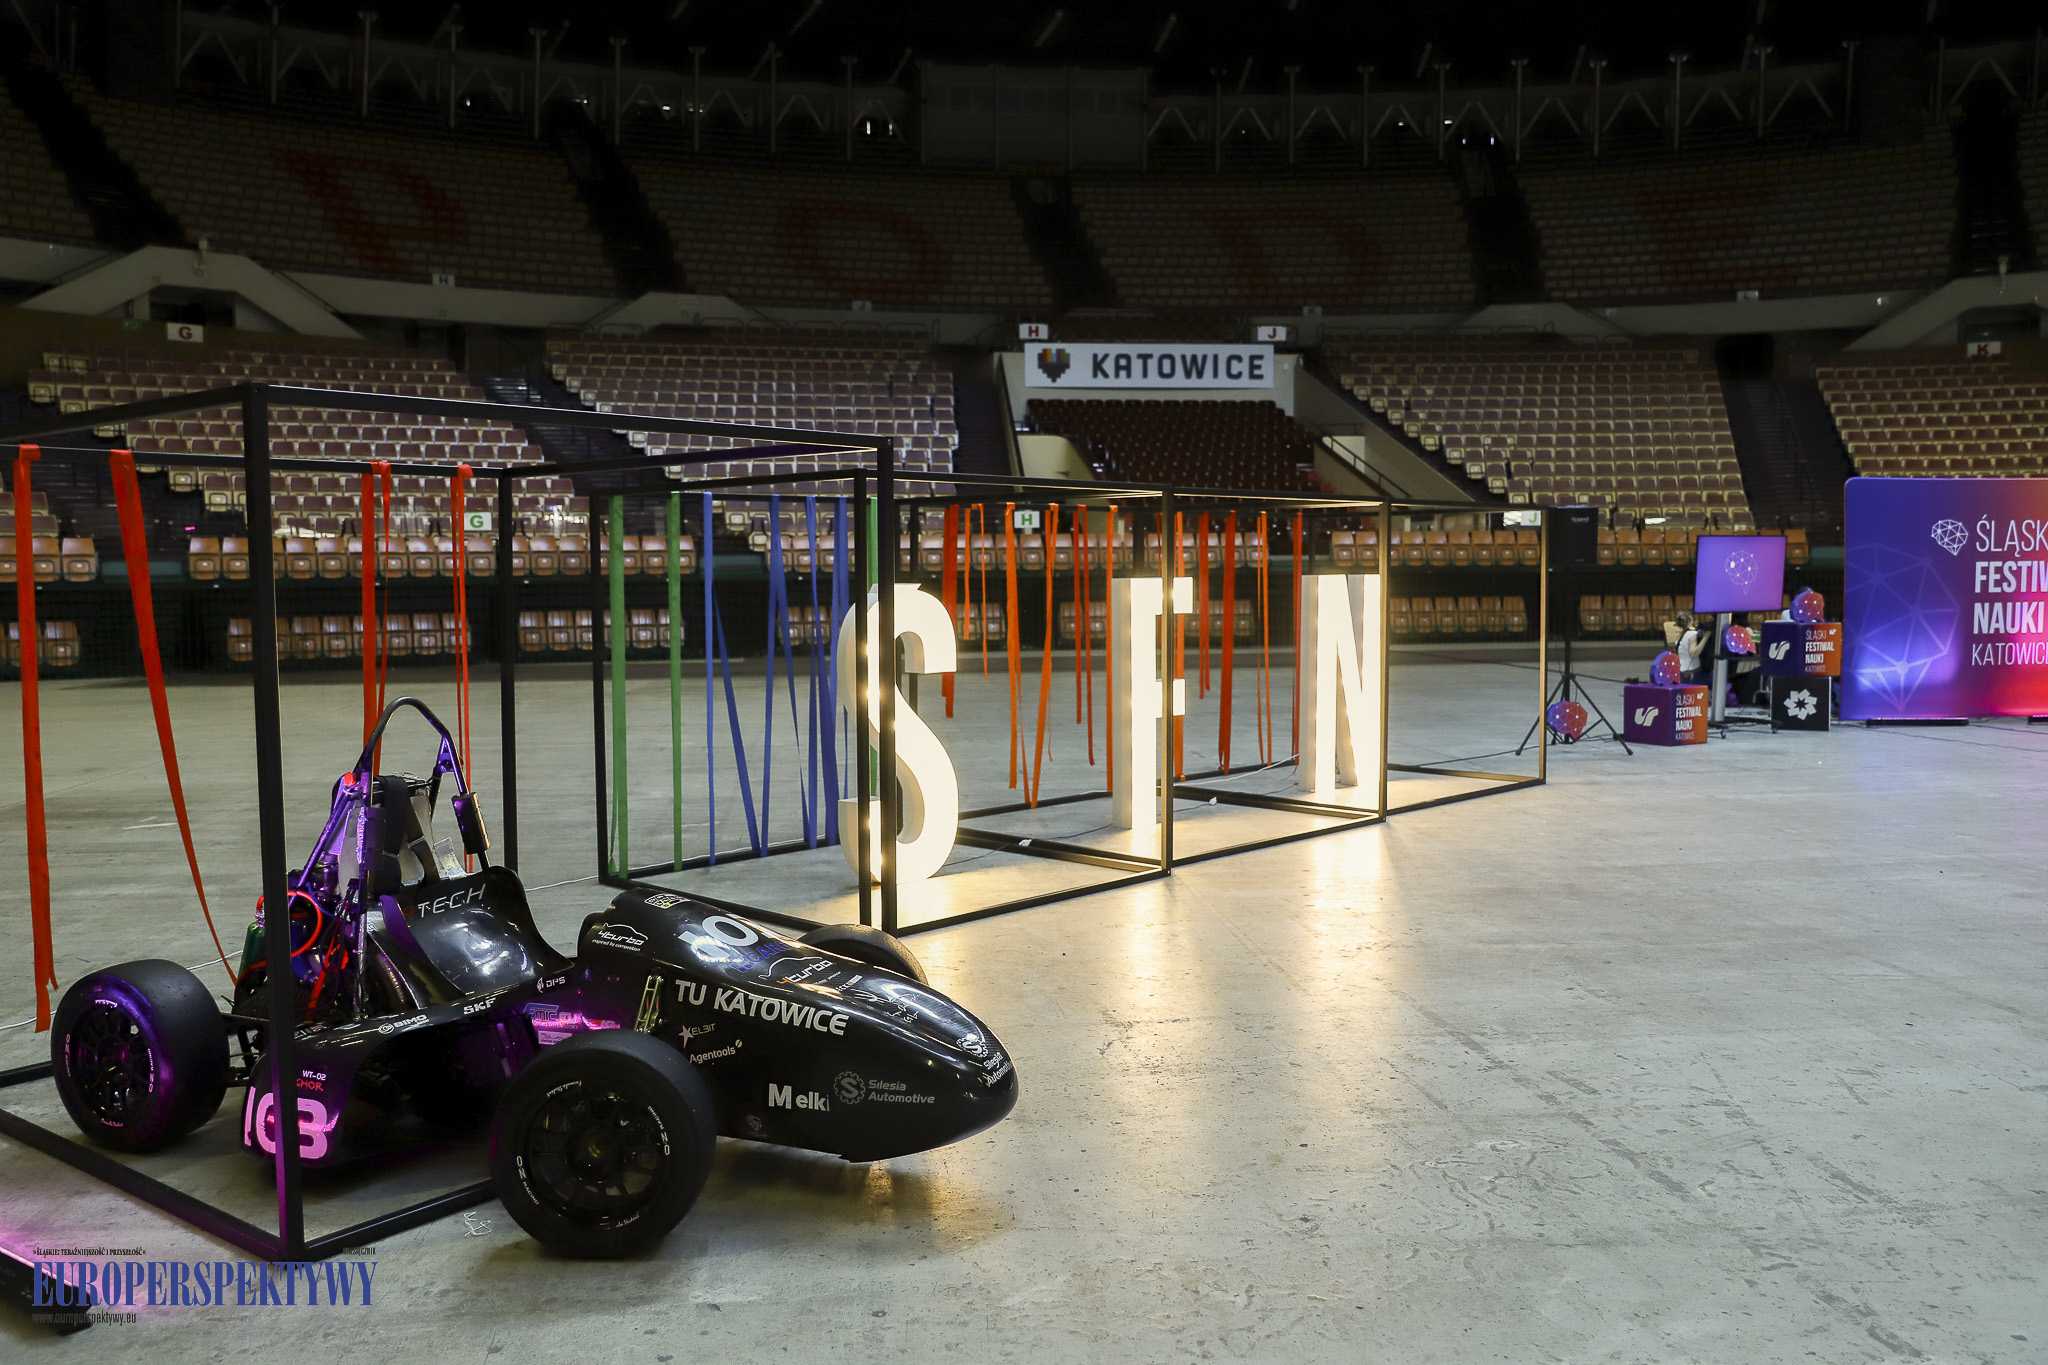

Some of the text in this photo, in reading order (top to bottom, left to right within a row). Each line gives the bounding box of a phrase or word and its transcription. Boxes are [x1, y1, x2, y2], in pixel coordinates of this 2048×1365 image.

[178, 327, 192, 340] G
[1028, 326, 1039, 337] H
[1267, 328, 1277, 338] J
[1092, 352, 1264, 379] KATOWICE
[469, 515, 484, 529] G
[1021, 514, 1033, 525] H
[1973, 601, 2045, 634] NAUKI
[1971, 641, 2048, 666] KATOWIC
[417, 884, 486, 919] TECH
[463, 997, 496, 1015] SKF
[675, 979, 850, 1036] TU KATOWICE
[689, 1046, 737, 1065] Agentools
[302, 1070, 327, 1081] WT-02
[868, 1079, 907, 1092] Silesia
[867, 1091, 936, 1104] Automotive
